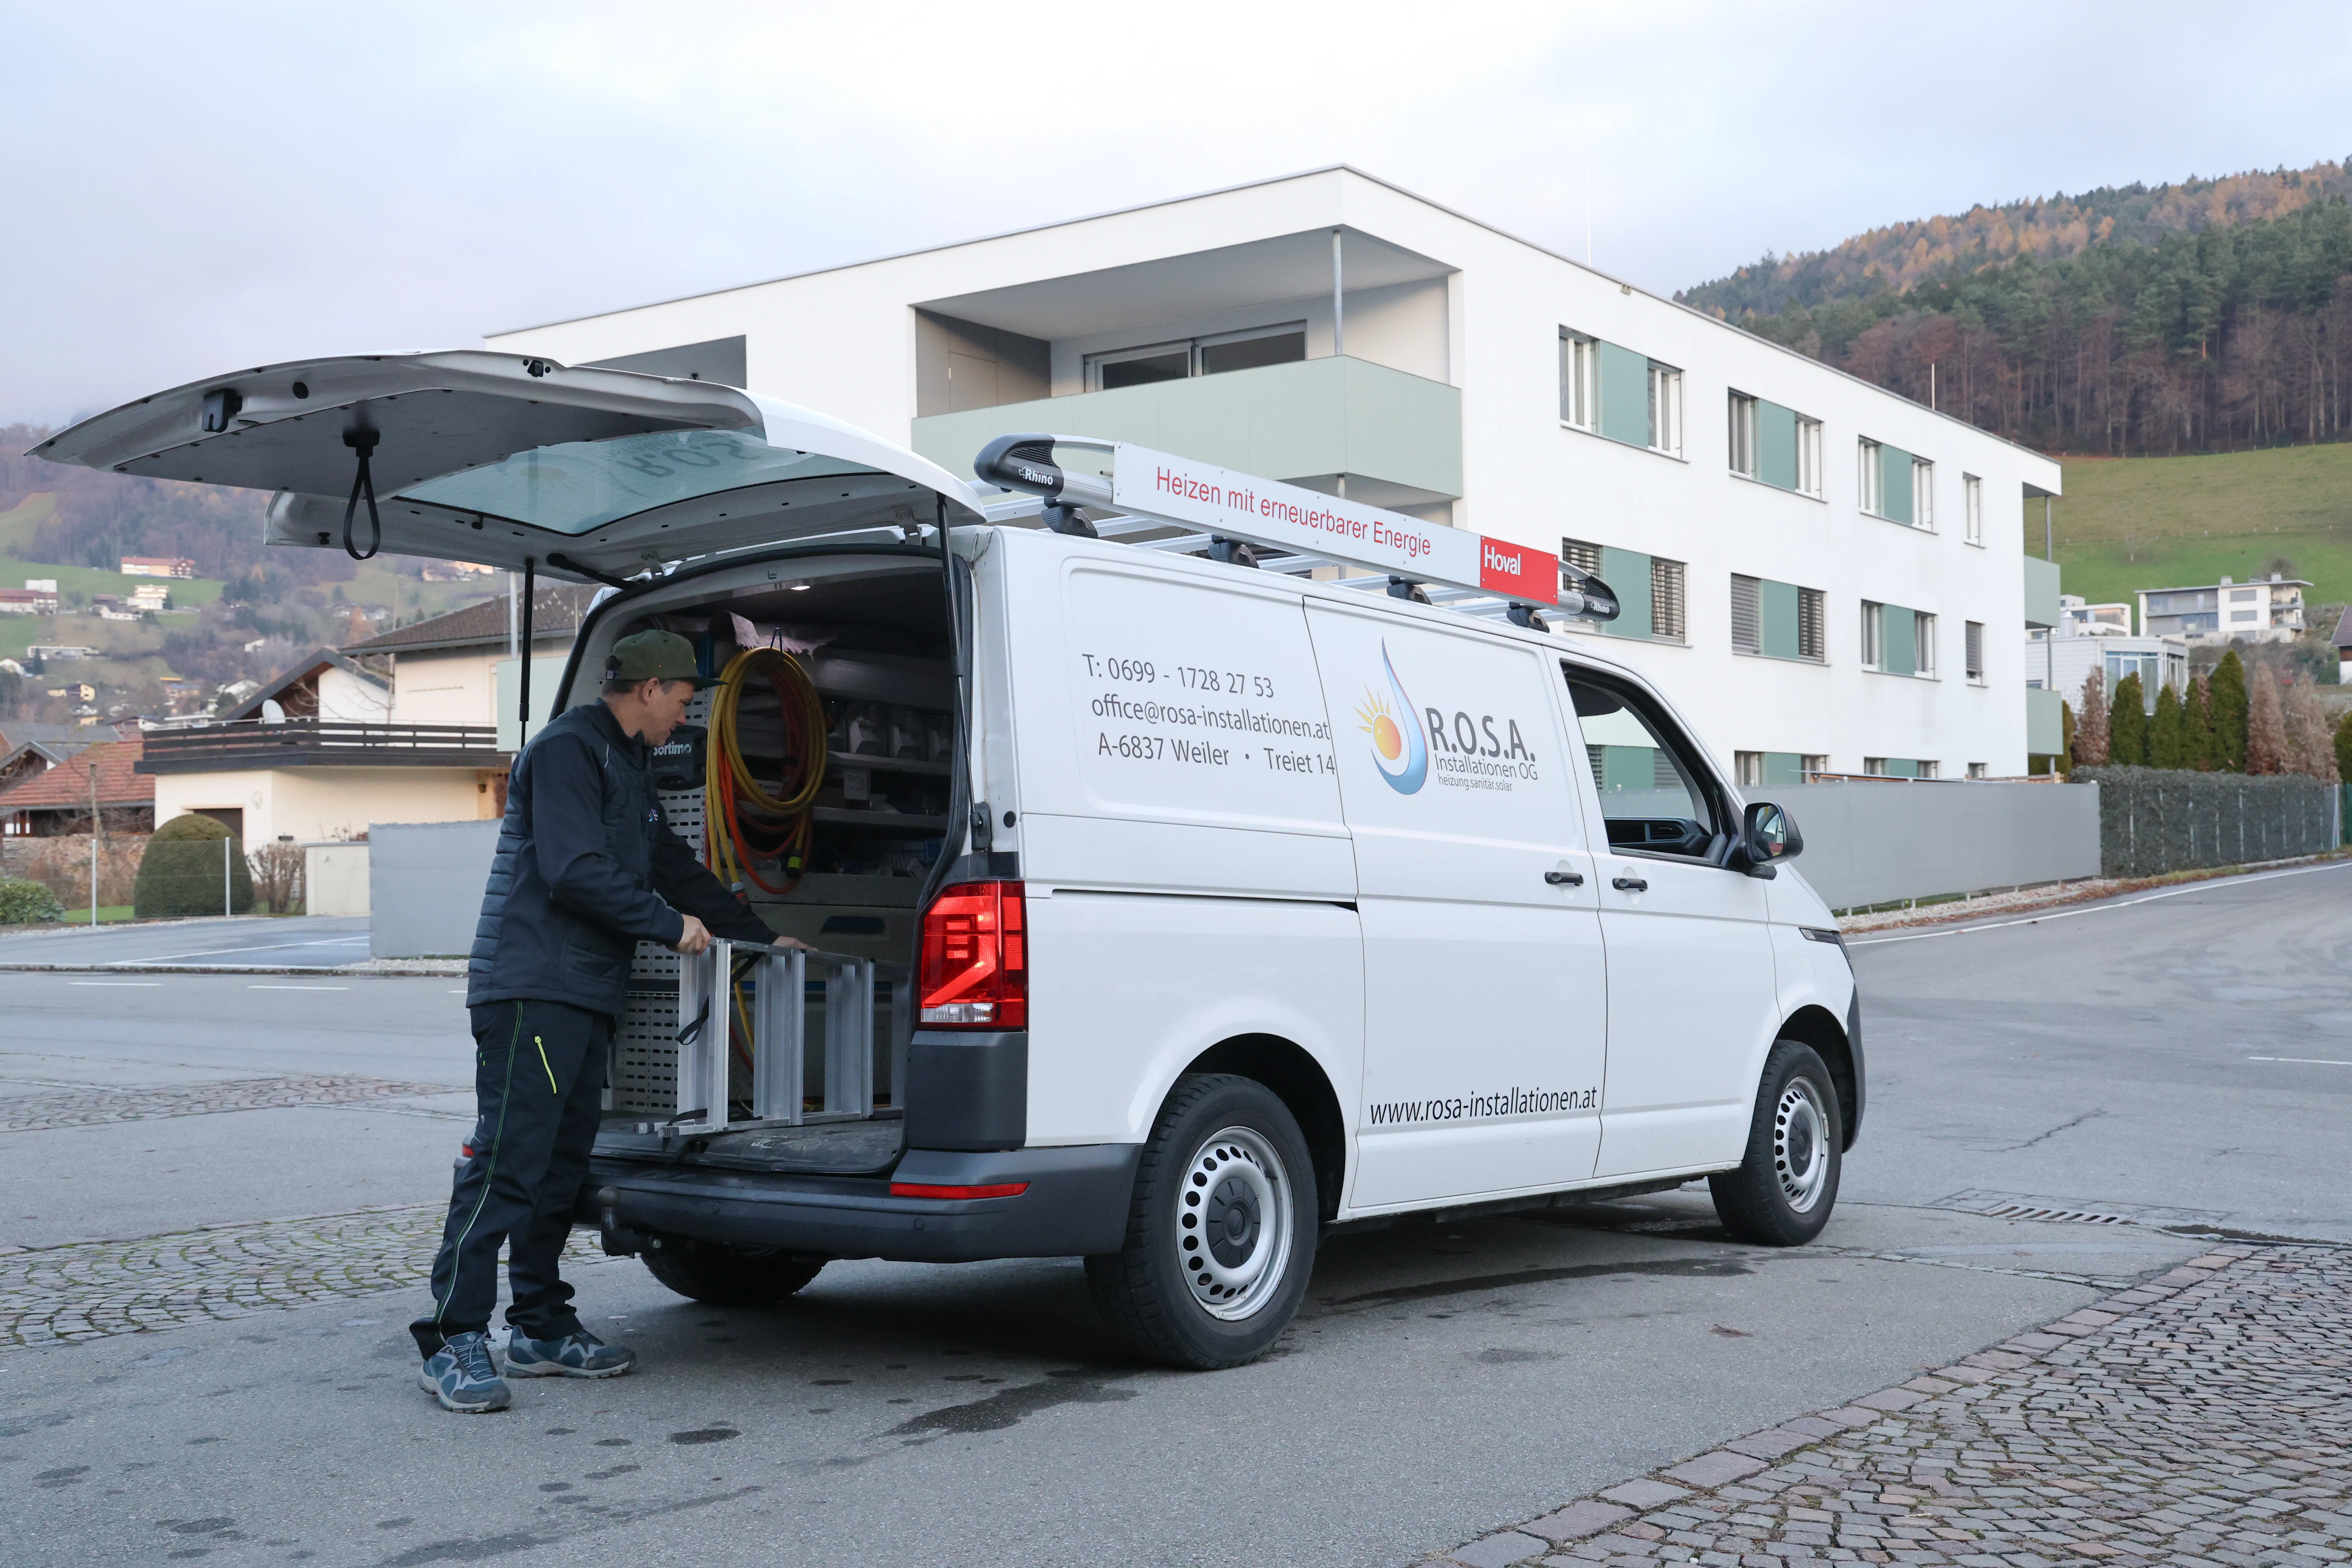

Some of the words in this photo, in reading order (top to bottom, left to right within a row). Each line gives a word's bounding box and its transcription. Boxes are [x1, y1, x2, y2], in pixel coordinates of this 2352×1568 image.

[1025, 468, 1054, 486] Rhino
[1157, 467, 1220, 504] Heizen
[1229, 491, 1254, 513] mit
[1261, 499, 1368, 538] erneuerbarer
[1374, 521, 1430, 557] Energie
[1484, 544, 1521, 575] Hoval
[1593, 602, 1610, 613] Rhino
[1082, 653, 1102, 678] T:
[1108, 657, 1155, 683] 0699
[1178, 666, 1220, 691] 1728
[1226, 673, 1245, 694] 27
[1254, 676, 1274, 698] 53
[1092, 693, 1330, 740] office@rosa-installationen.at
[1425, 708, 1535, 762] R.O.S.A.
[1098, 732, 1164, 760] A-6837
[1171, 739, 1229, 765] Weiler
[1263, 748, 1313, 773] Treiet
[1316, 754, 1335, 775] 14
[1434, 753, 1517, 778] Installationen
[1519, 762, 1538, 780] OG
[1437, 773, 1512, 791] heizung.sanitär.solar
[1370, 1086, 1597, 1125] www.rosa-installationen.at
